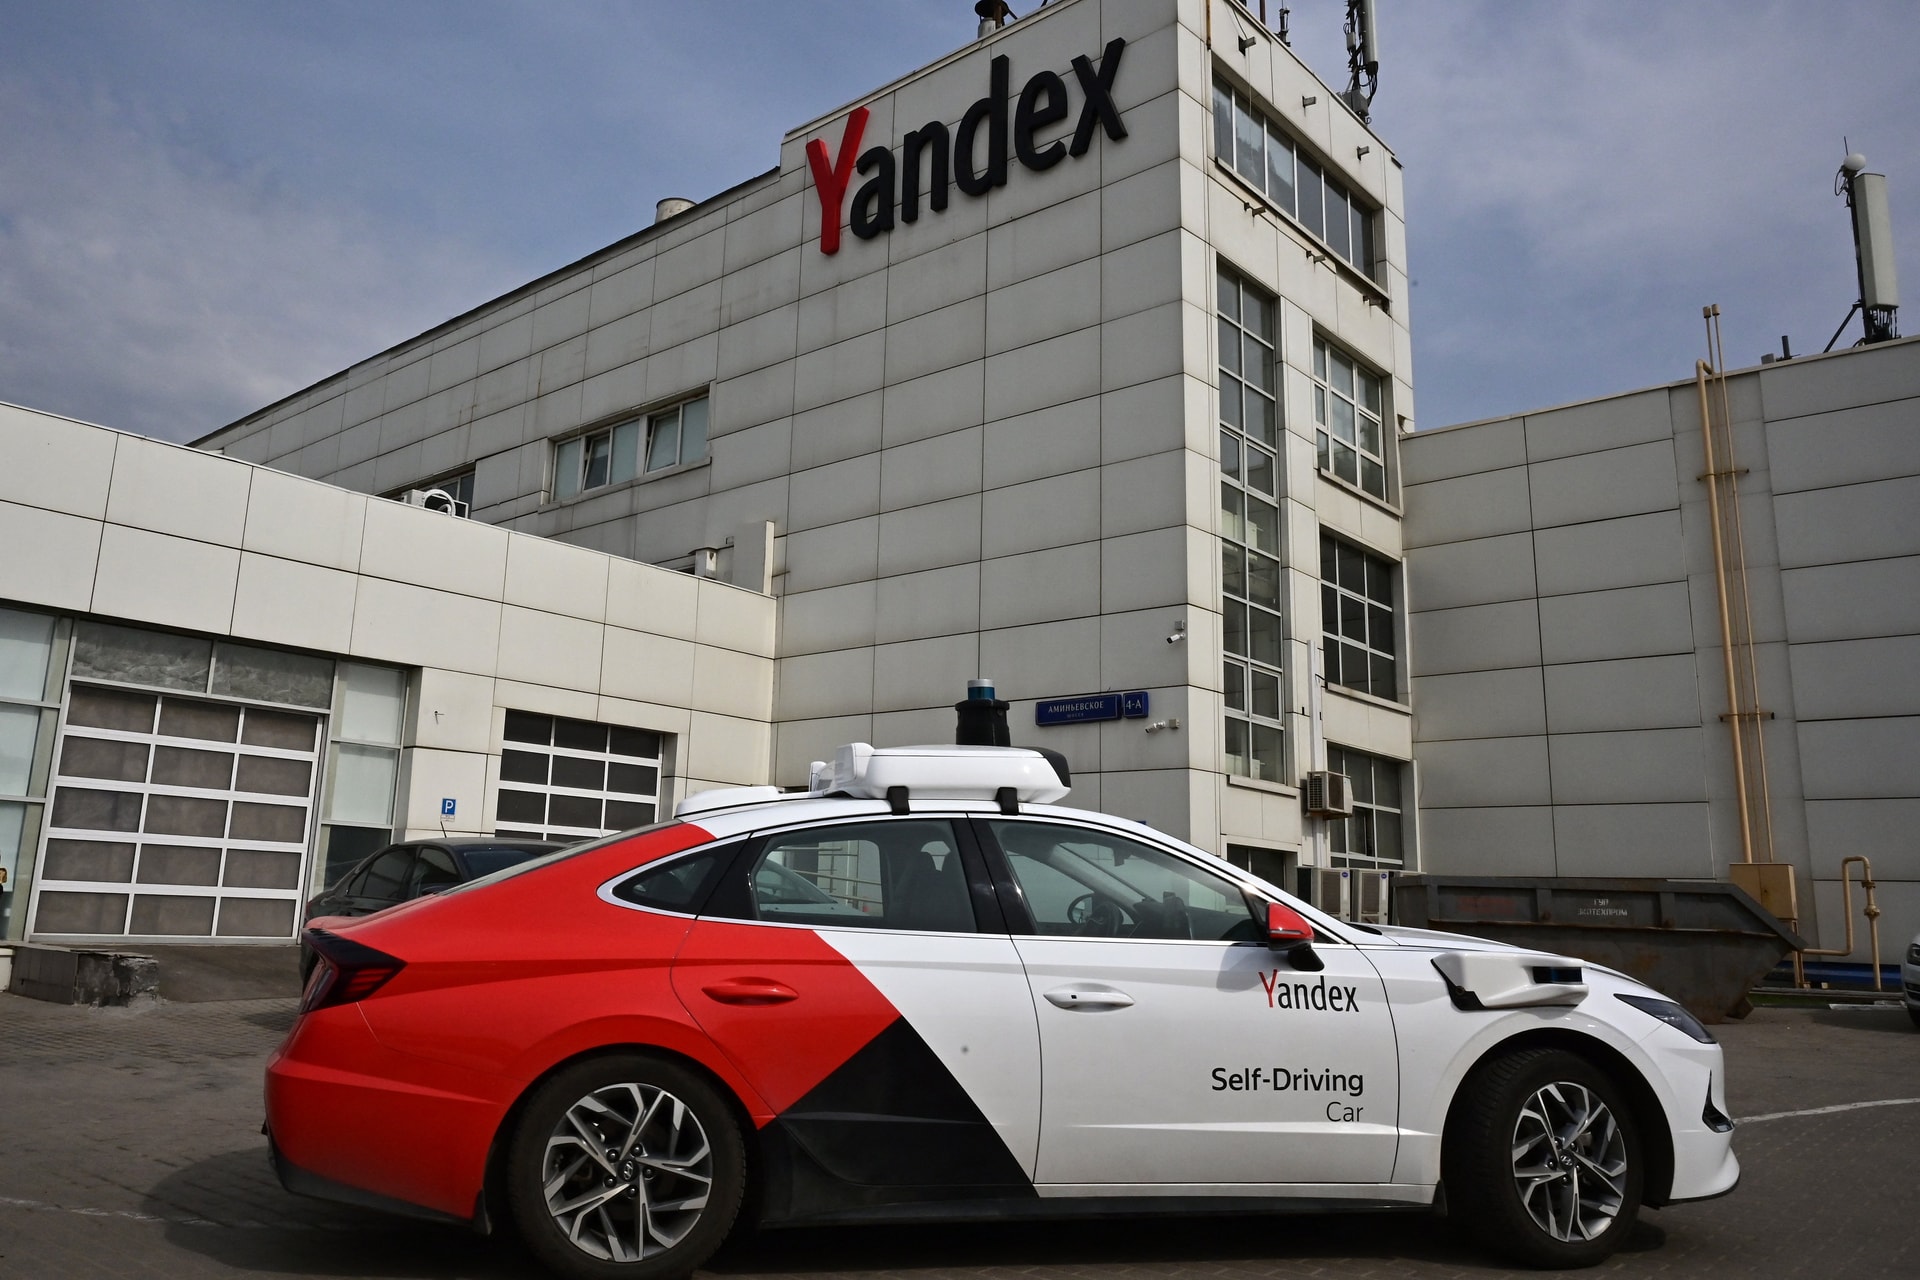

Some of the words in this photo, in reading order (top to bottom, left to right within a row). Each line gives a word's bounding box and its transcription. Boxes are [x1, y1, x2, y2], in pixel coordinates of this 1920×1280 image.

[806, 37, 1128, 255] Yandex
[1048, 701, 1104, 713] АМИНЬЕВСКОЕ
[445, 800, 454, 813] P
[1258, 969, 1359, 1012] Yandex
[1211, 1067, 1364, 1097] Self-Driving
[1326, 1101, 1364, 1122] Car
